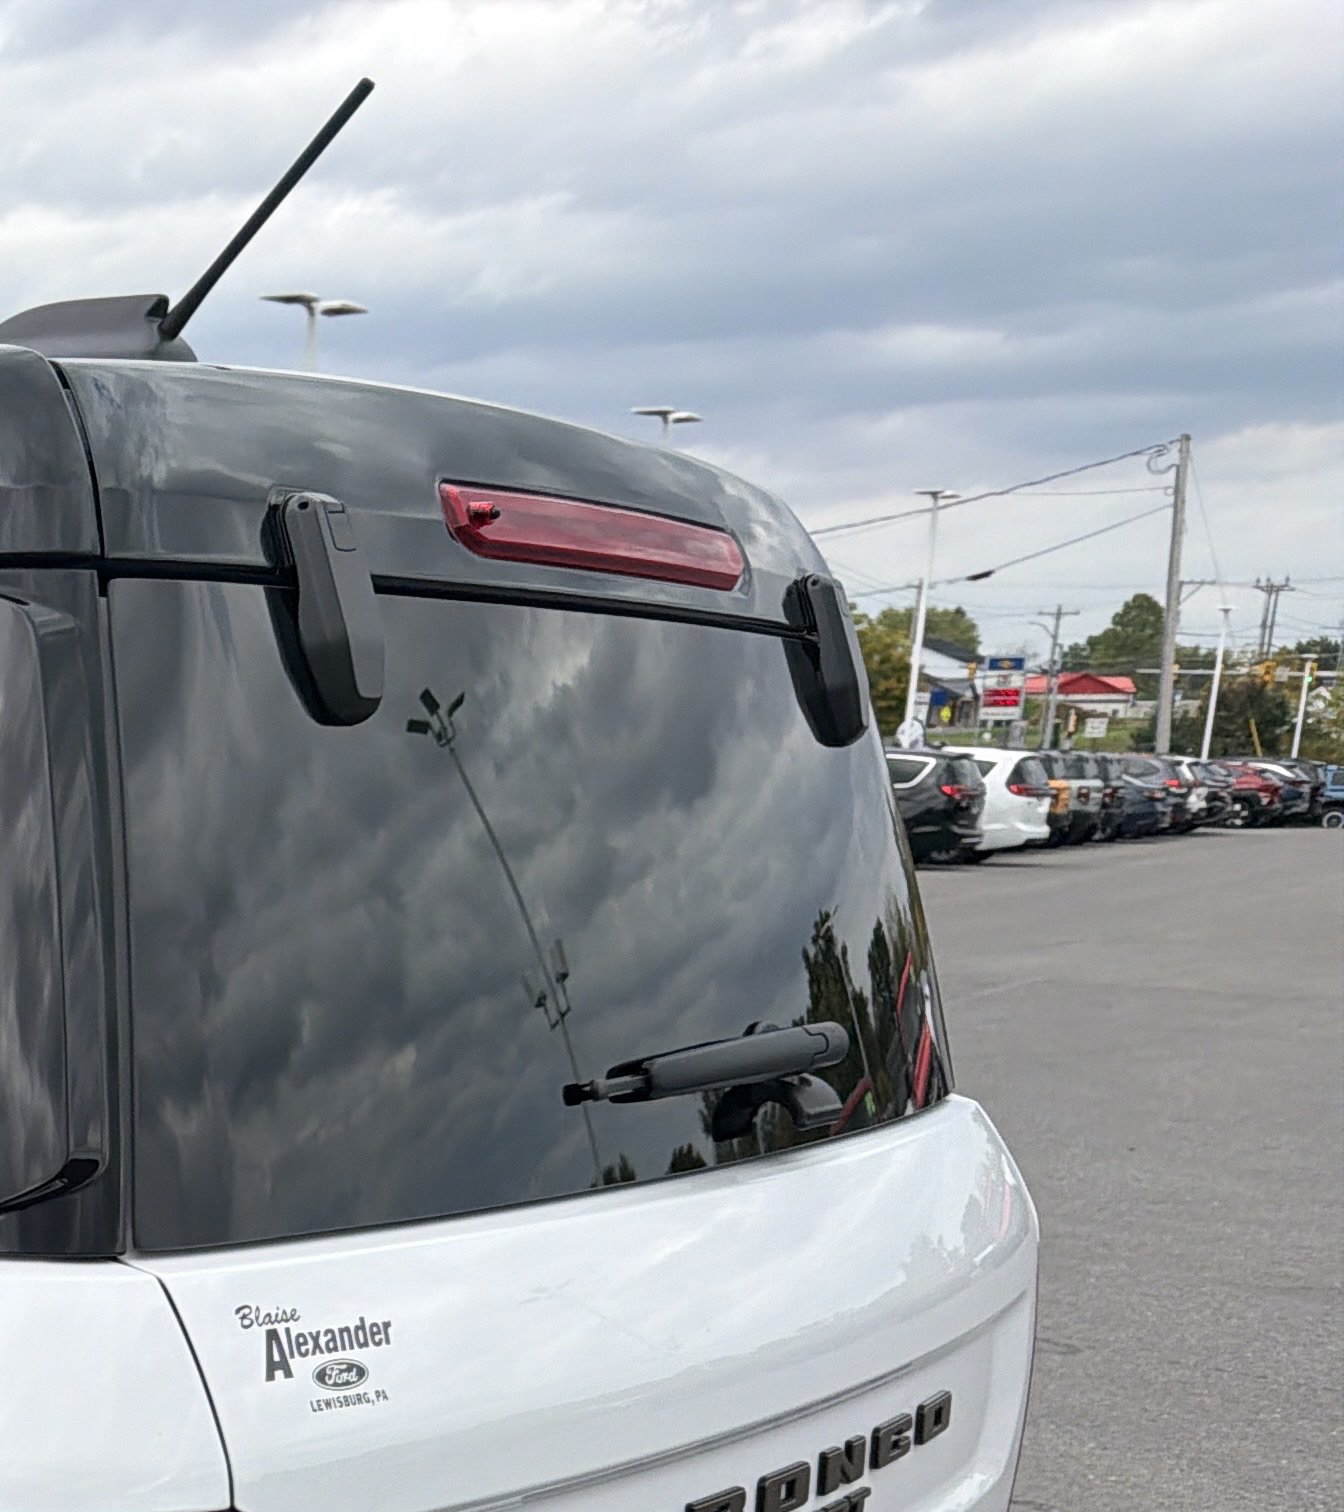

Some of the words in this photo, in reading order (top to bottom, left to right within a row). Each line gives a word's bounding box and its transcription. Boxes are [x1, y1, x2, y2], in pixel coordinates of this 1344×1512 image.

[235, 1304, 301, 1330] Blaise
[265, 1316, 392, 1383] Alexander
[310, 1392, 375, 1413] LEWISBURG,
[375, 1388, 389, 1403] PA
